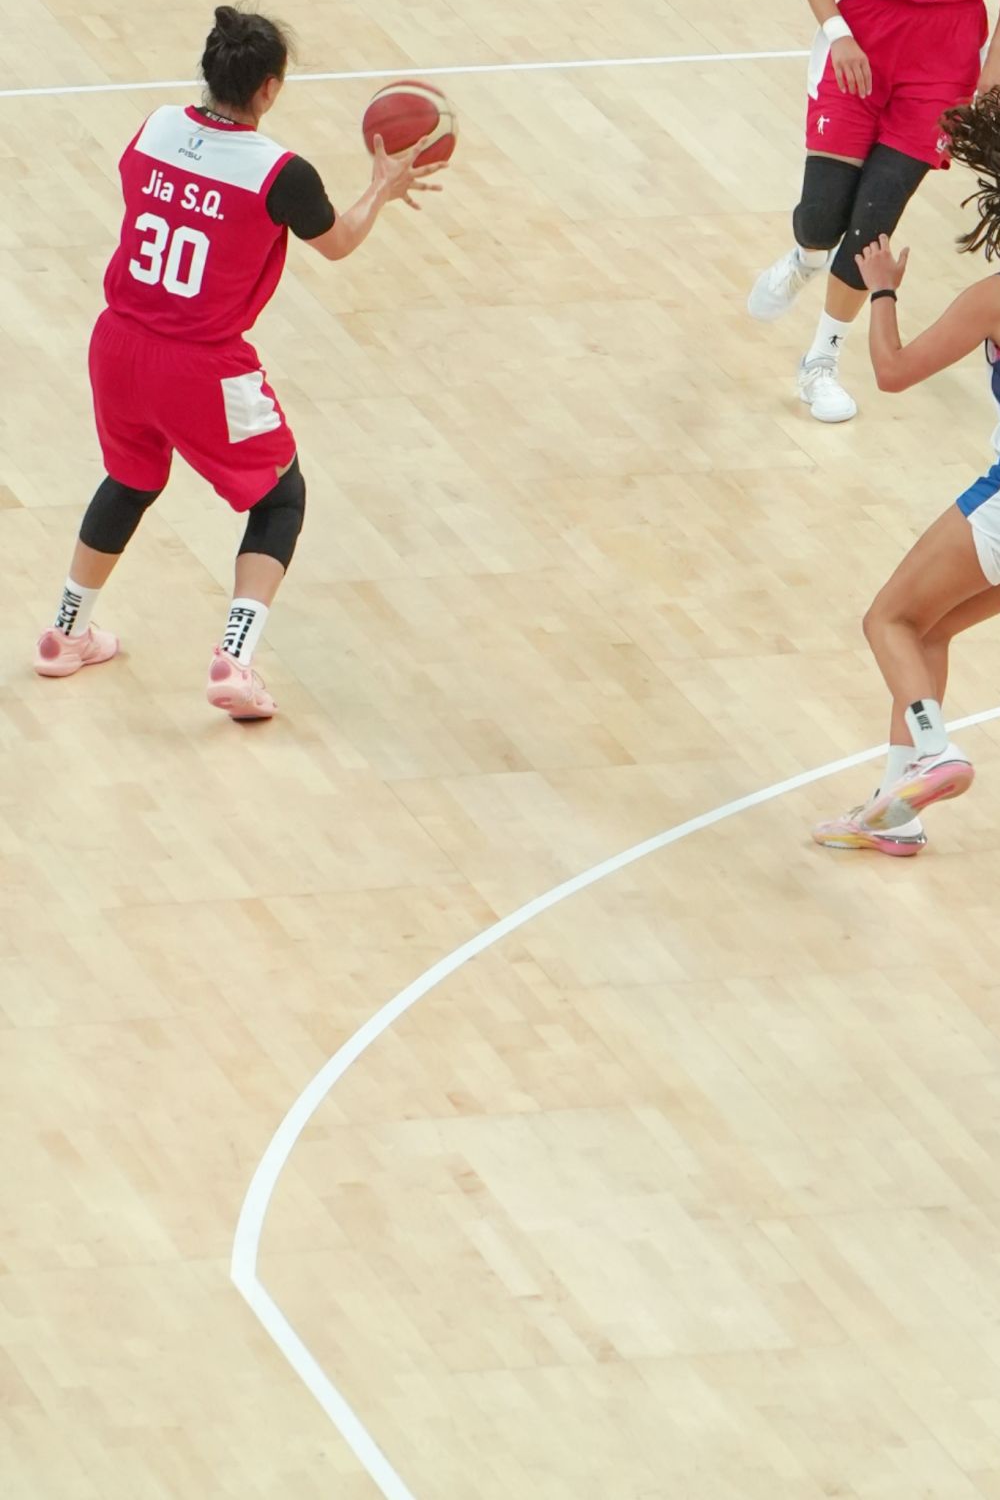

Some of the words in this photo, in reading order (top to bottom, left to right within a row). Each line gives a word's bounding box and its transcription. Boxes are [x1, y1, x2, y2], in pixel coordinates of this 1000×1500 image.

[142, 169, 175, 203] Jia
[180, 183, 224, 220] S.Q.
[128, 212, 210, 299] 30
